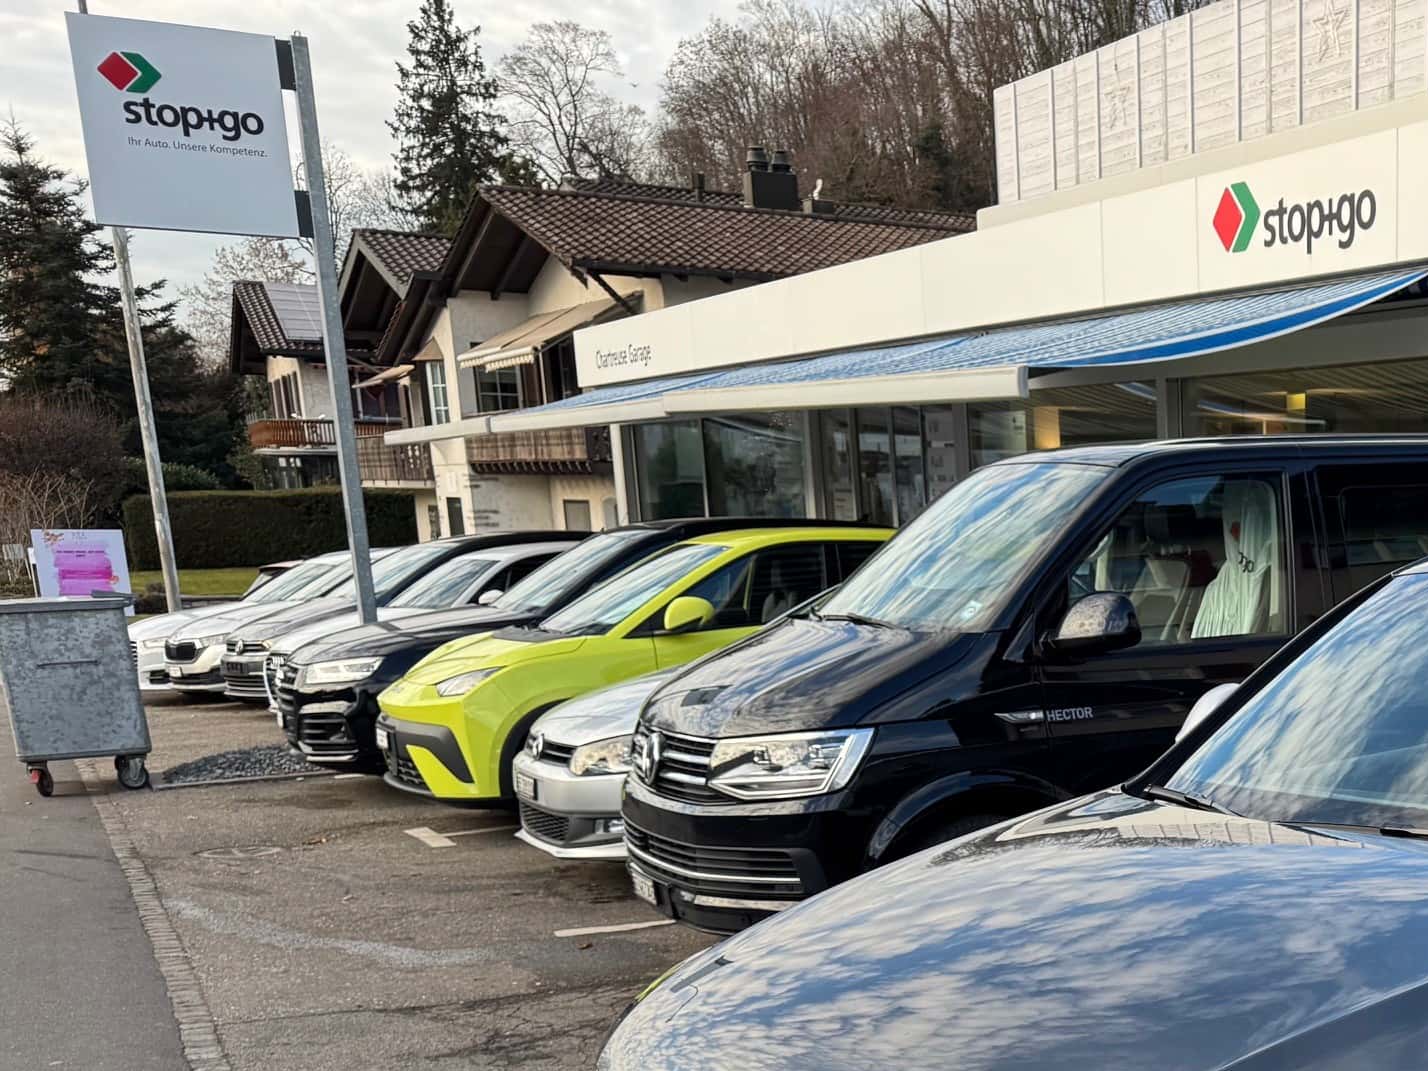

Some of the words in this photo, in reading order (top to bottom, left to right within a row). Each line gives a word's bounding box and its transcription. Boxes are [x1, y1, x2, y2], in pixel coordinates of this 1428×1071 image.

[123, 97, 265, 142] stop+go
[127, 136, 142, 147] Ihr
[144, 138, 171, 149] Auto.
[173, 141, 208, 153] Unsere
[209, 143, 268, 158] Kompetenz.
[1263, 189, 1377, 255] stop+go
[628, 343, 652, 367] Garage
[1046, 707, 1094, 721] HECTOR
